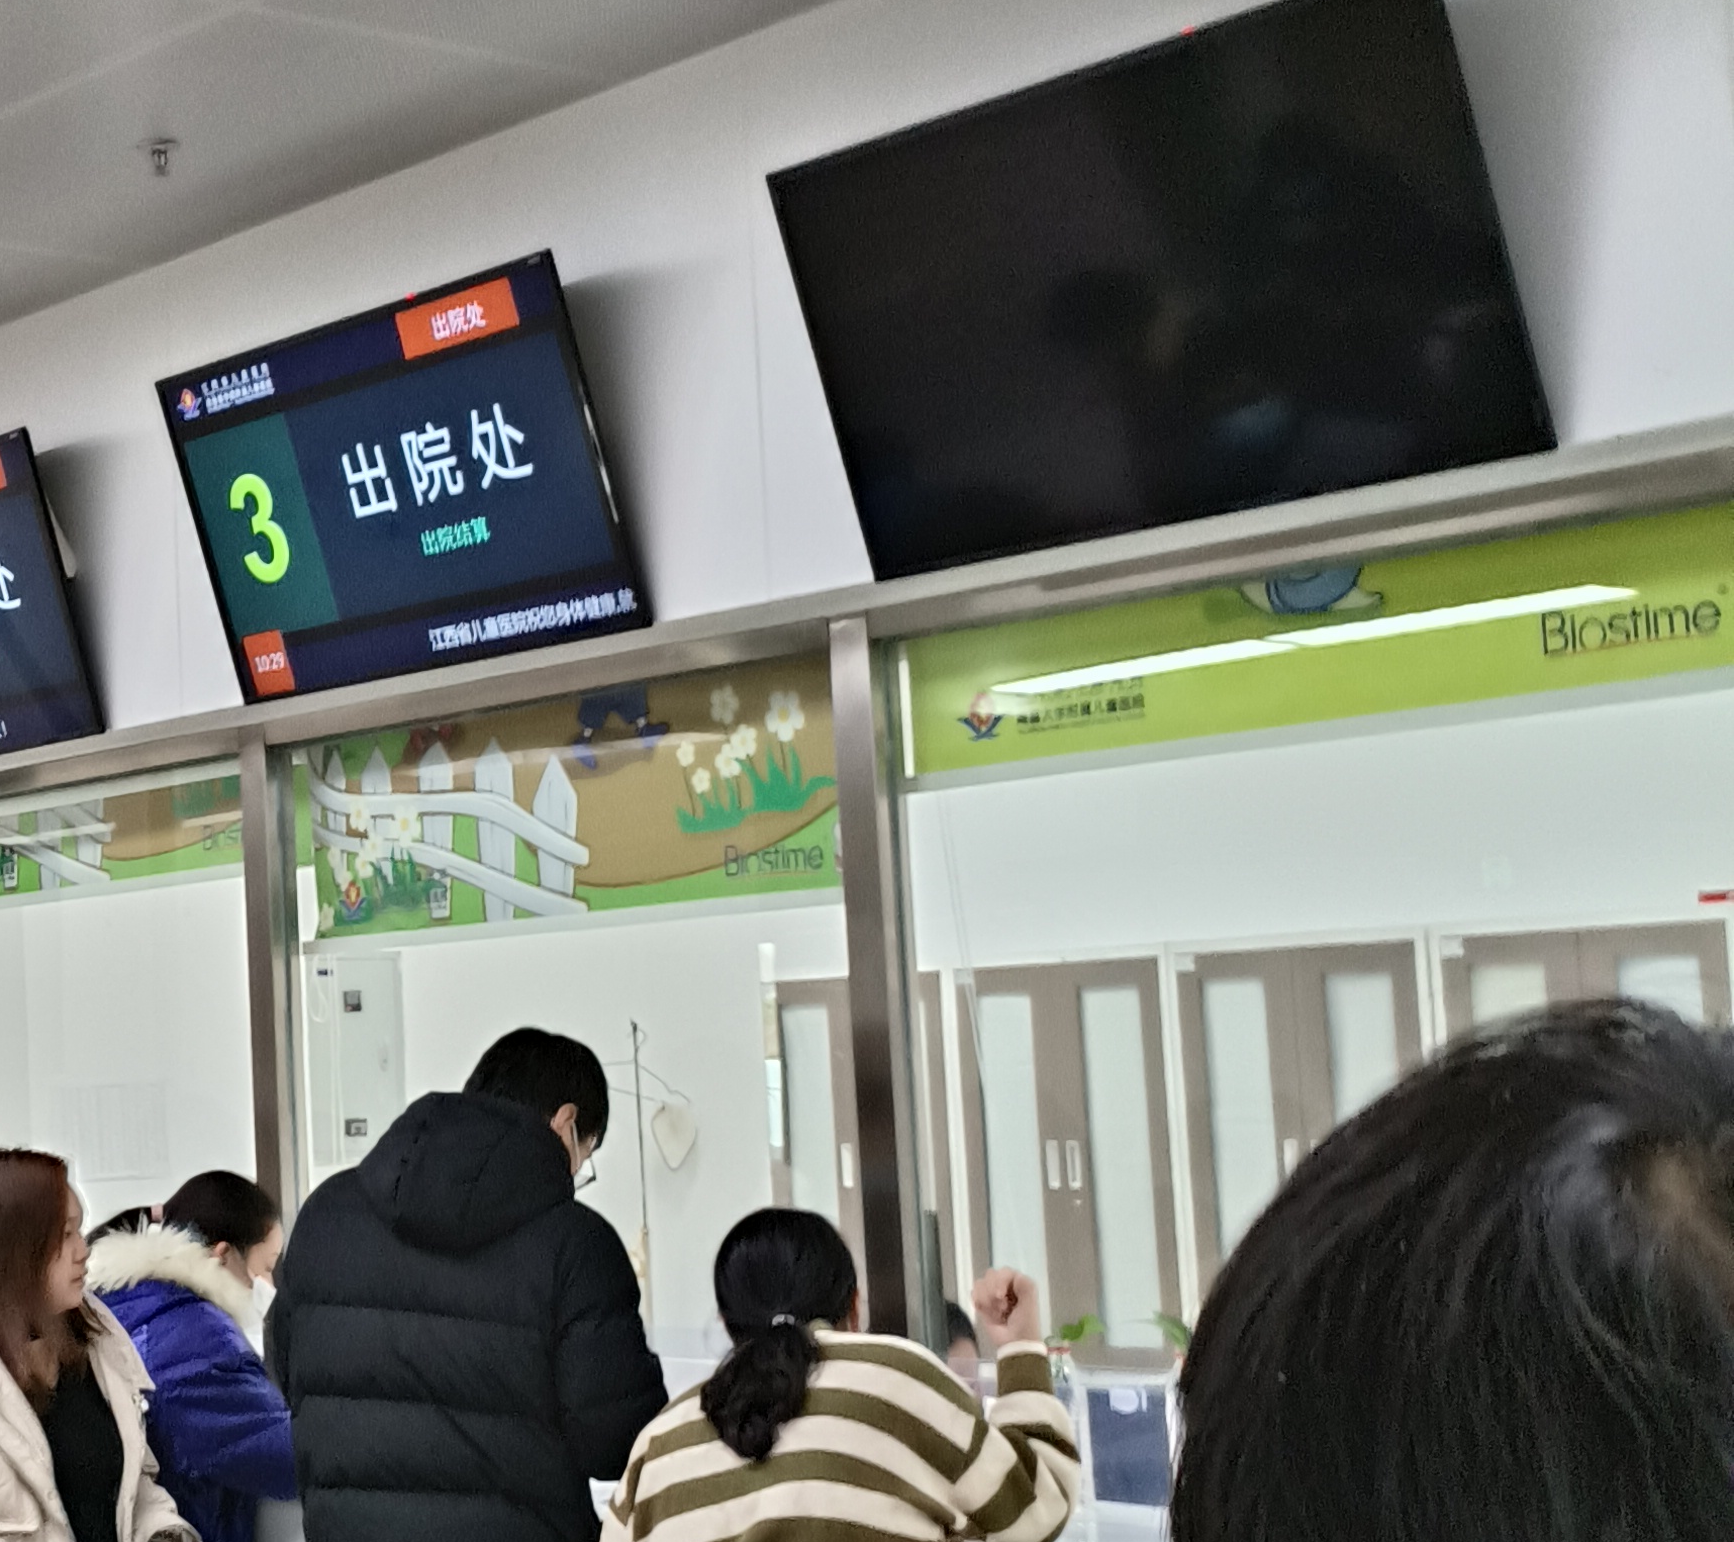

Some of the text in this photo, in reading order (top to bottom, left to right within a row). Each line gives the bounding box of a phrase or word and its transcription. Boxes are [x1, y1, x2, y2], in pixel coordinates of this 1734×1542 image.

[430, 301, 486, 341] 出院处
[341, 402, 534, 520] 出院处
[229, 473, 290, 583] 3
[1541, 599, 1722, 657] Biostime
